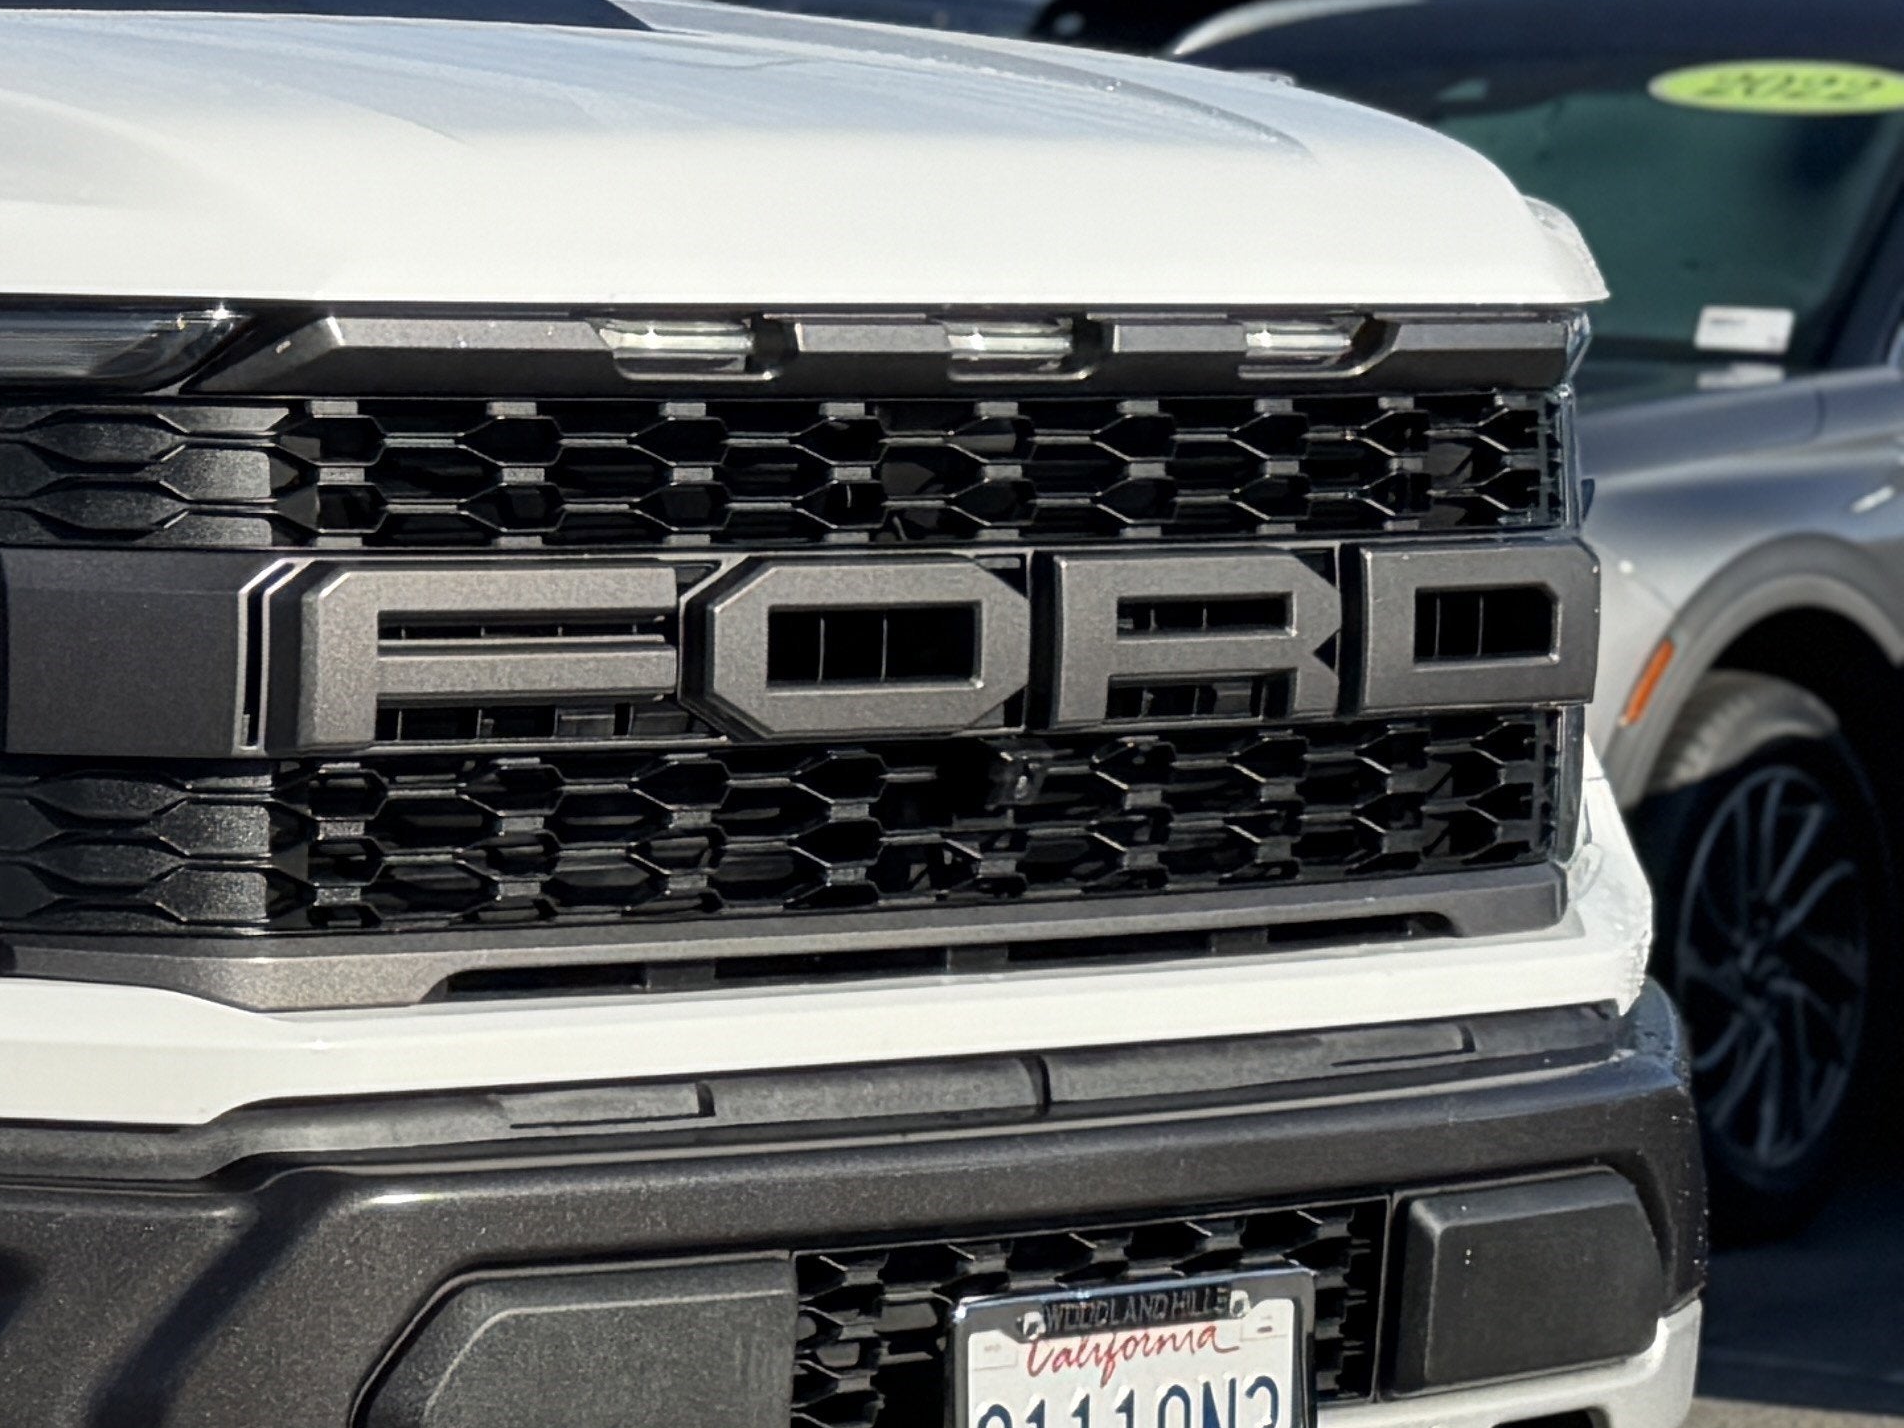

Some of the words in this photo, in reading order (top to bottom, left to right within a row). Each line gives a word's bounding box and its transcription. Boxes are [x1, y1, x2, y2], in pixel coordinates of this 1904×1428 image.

[292, 539, 1600, 751] FORD
[1044, 1293, 1169, 1334] WOODLAND
[1026, 1324, 1240, 1389] California
